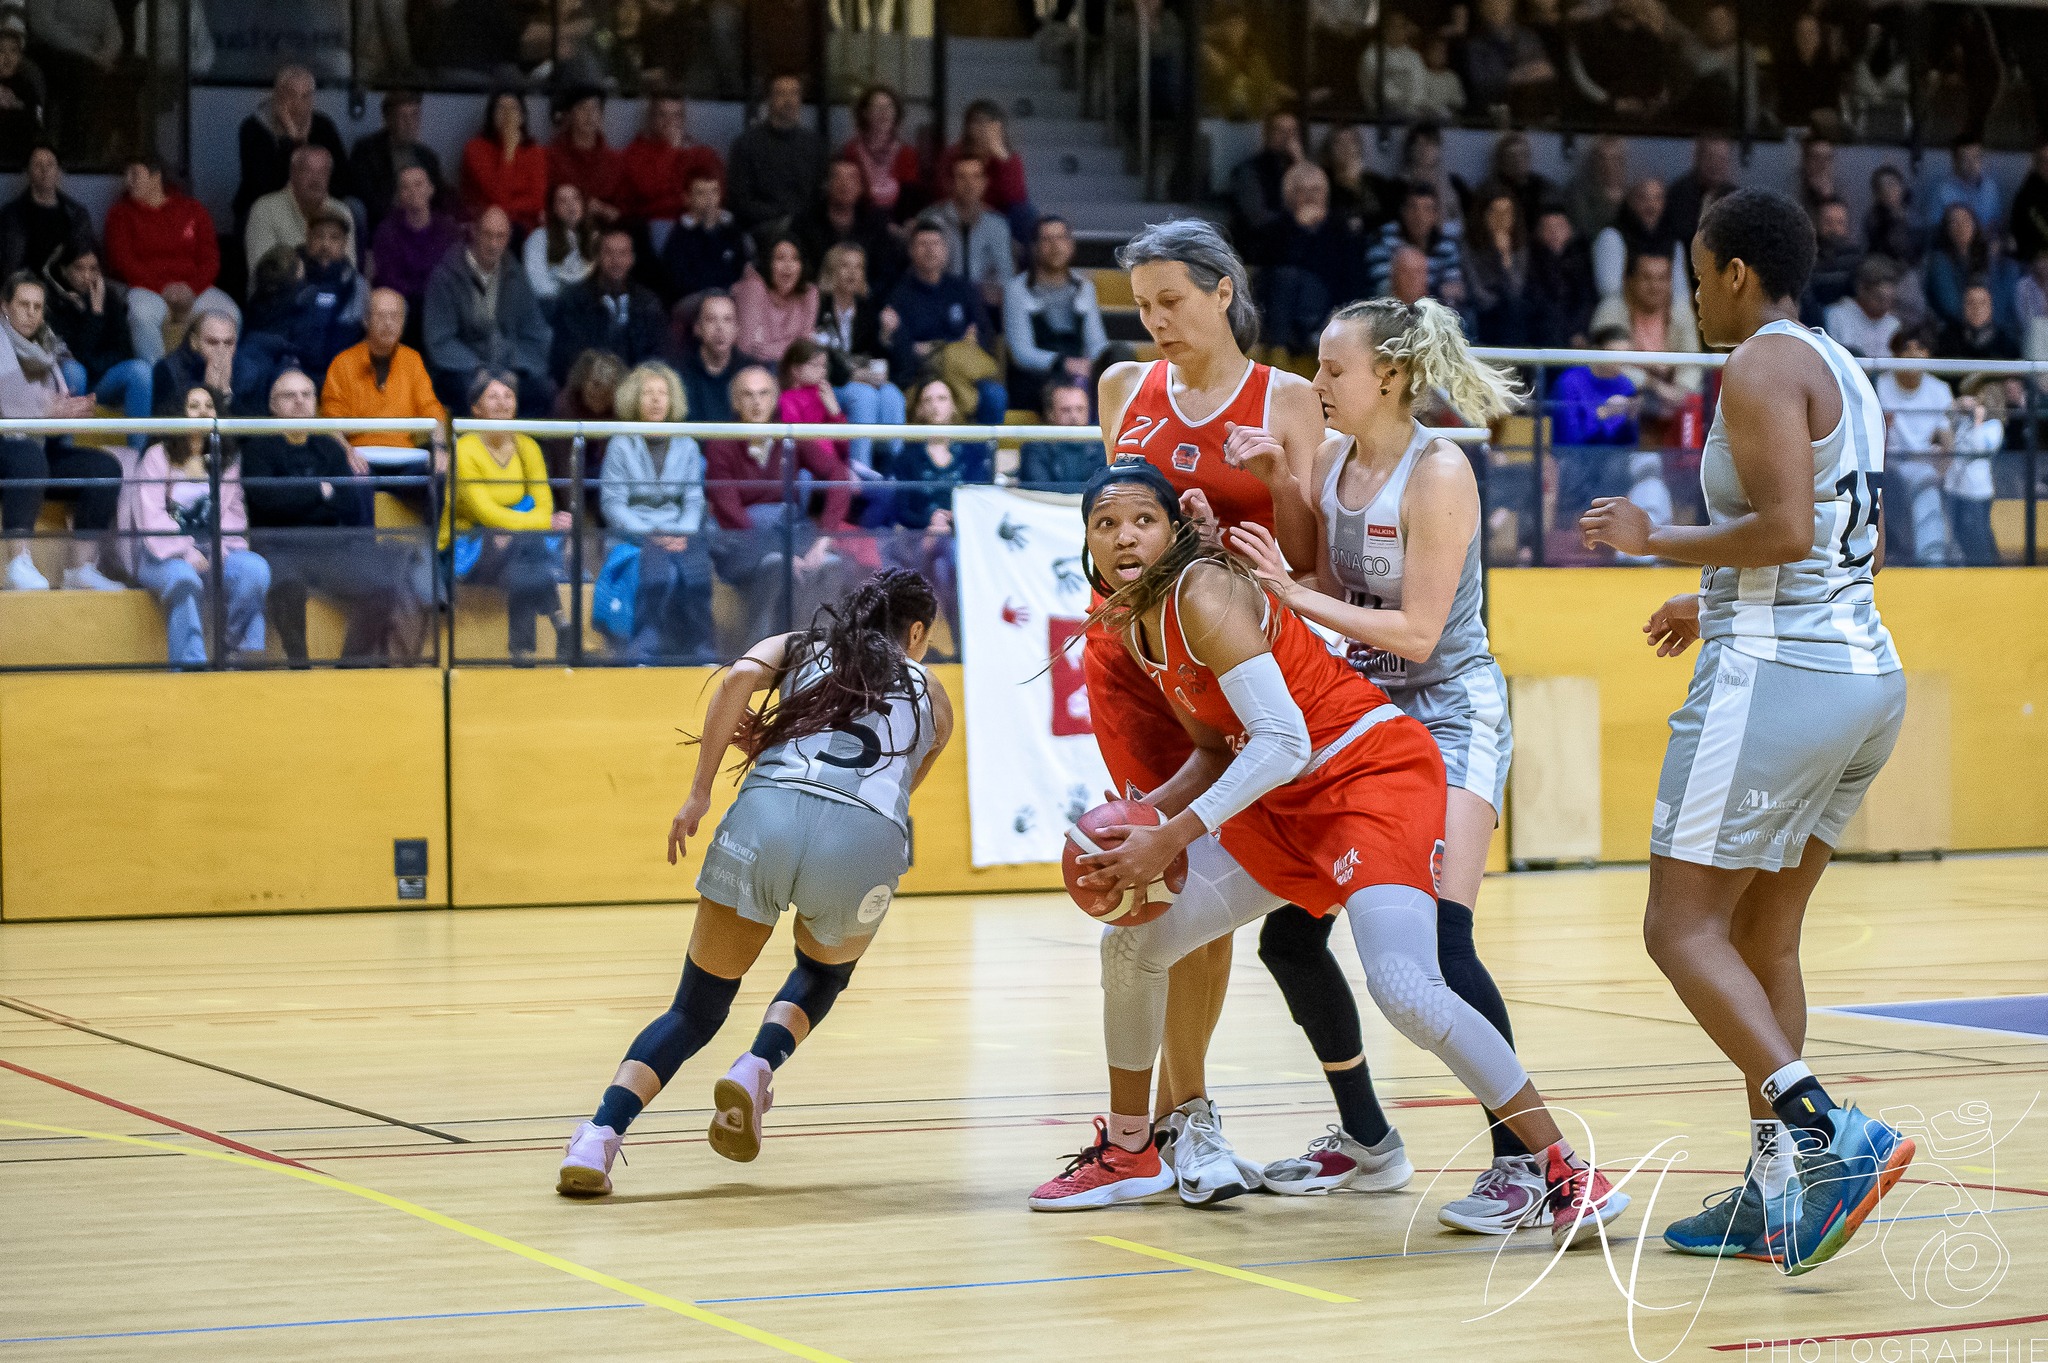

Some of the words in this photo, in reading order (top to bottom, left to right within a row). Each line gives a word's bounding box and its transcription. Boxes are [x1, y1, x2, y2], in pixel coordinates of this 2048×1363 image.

[1118, 415, 1169, 448] 21
[1369, 527, 1395, 536] BALKIN
[1330, 546, 1390, 577] ONACO
[814, 699, 893, 769] 5
[1756, 1123, 1778, 1160] PEAK
